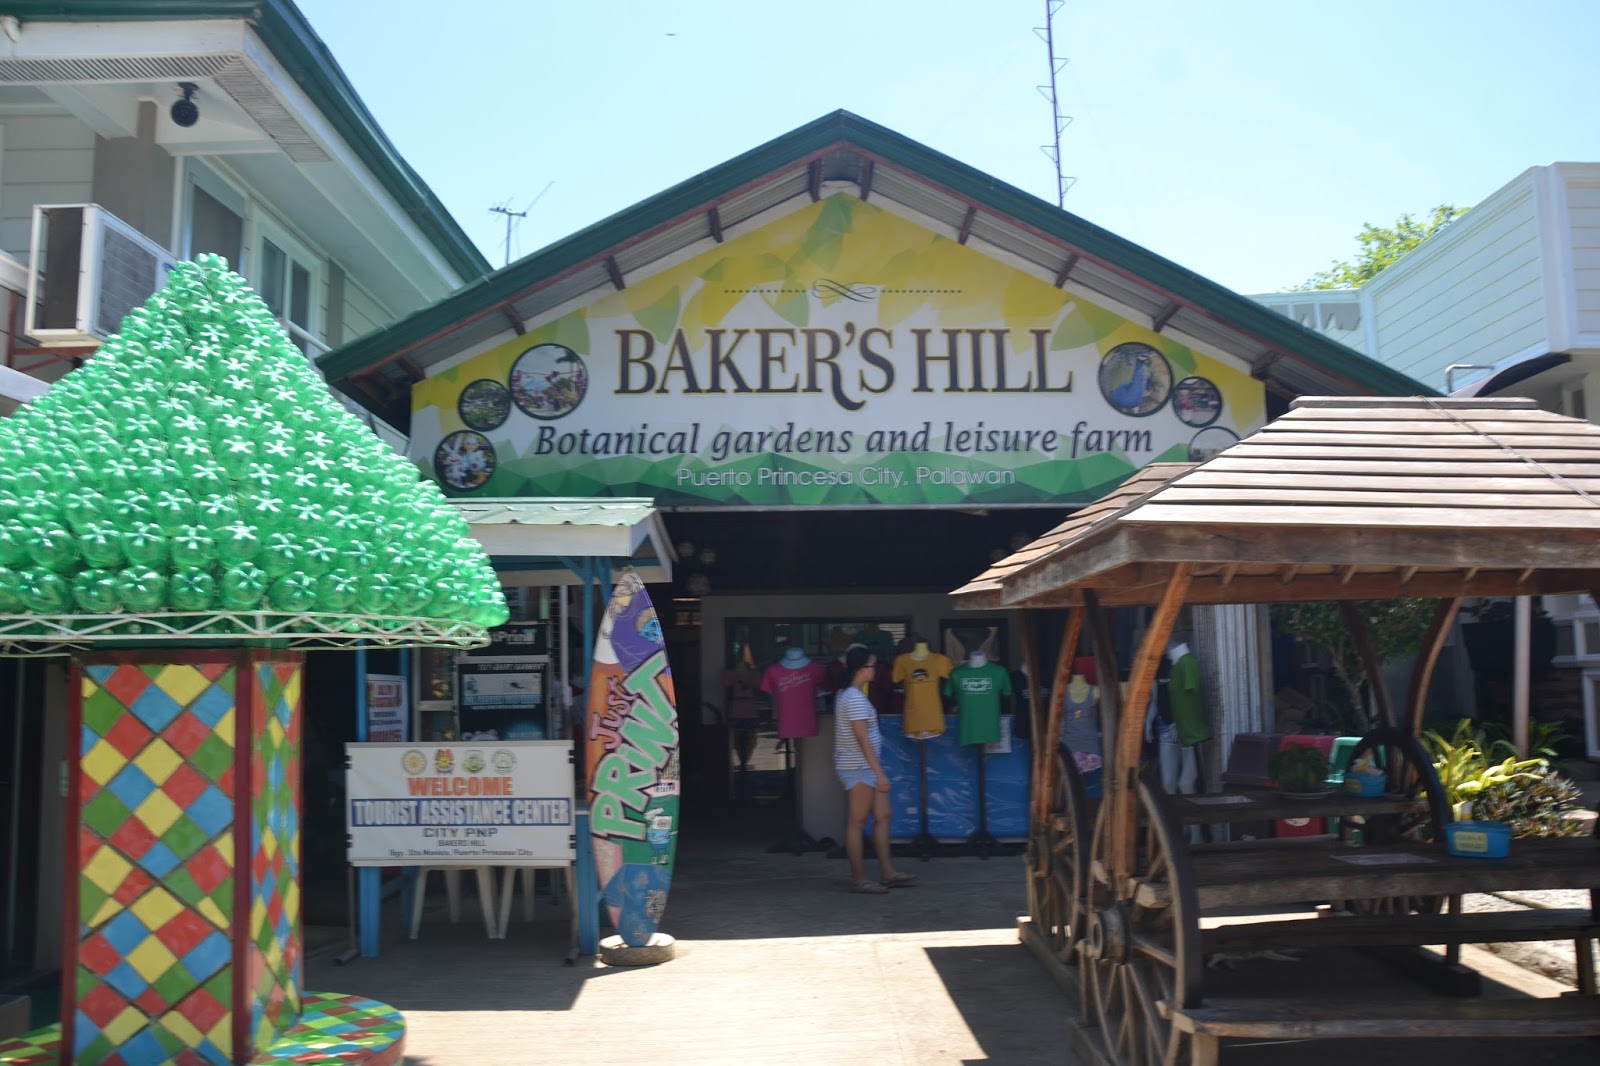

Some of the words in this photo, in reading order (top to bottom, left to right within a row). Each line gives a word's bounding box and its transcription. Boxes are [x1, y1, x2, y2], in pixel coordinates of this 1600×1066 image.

[614, 321, 895, 410] BAKER'S
[910, 328, 1073, 393] HILL
[535, 423, 698, 455] Botanical
[712, 423, 851, 460] gardens
[867, 423, 930, 452] and
[945, 421, 1059, 453] leisure
[1069, 421, 1153, 460] farm
[677, 467, 751, 486] Puerto
[757, 466, 853, 486] Princesa
[858, 466, 909, 489] City,
[916, 466, 1015, 485] Palawan
[408, 777, 513, 795] WELCOME
[354, 801, 418, 825] TOURIST
[420, 800, 511, 825] ASSISTANCE
[512, 800, 569, 824] CENTER
[423, 828, 459, 838] CITY
[464, 828, 498, 838] PNP
